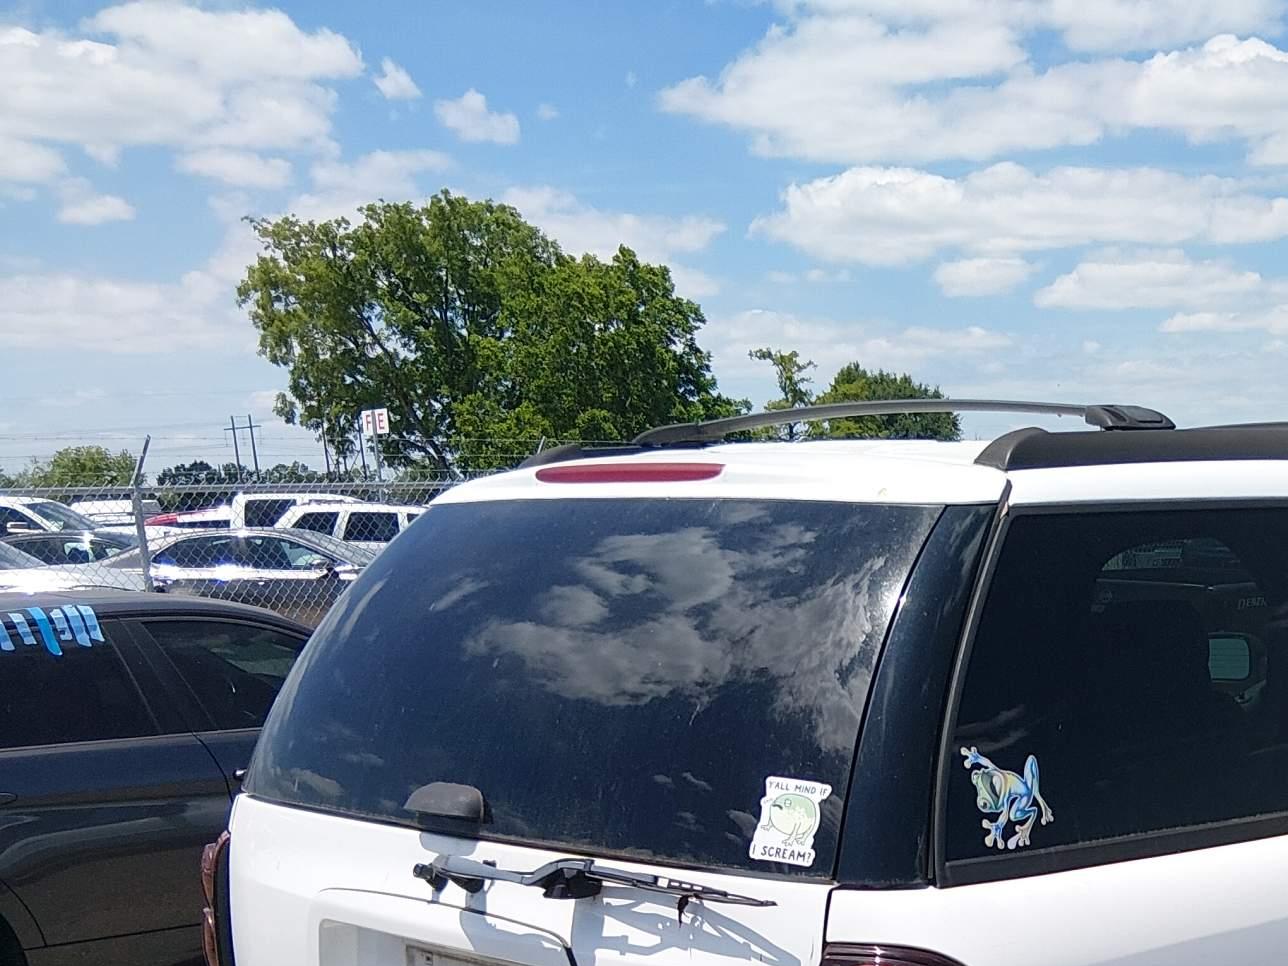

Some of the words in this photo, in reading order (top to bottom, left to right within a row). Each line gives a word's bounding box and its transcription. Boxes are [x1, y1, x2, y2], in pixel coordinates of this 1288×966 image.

[768, 780, 790, 792] Y'ALL
[793, 784, 817, 795] MIND
[819, 787, 829, 797] IF
[760, 845, 812, 864] SCREAM?
